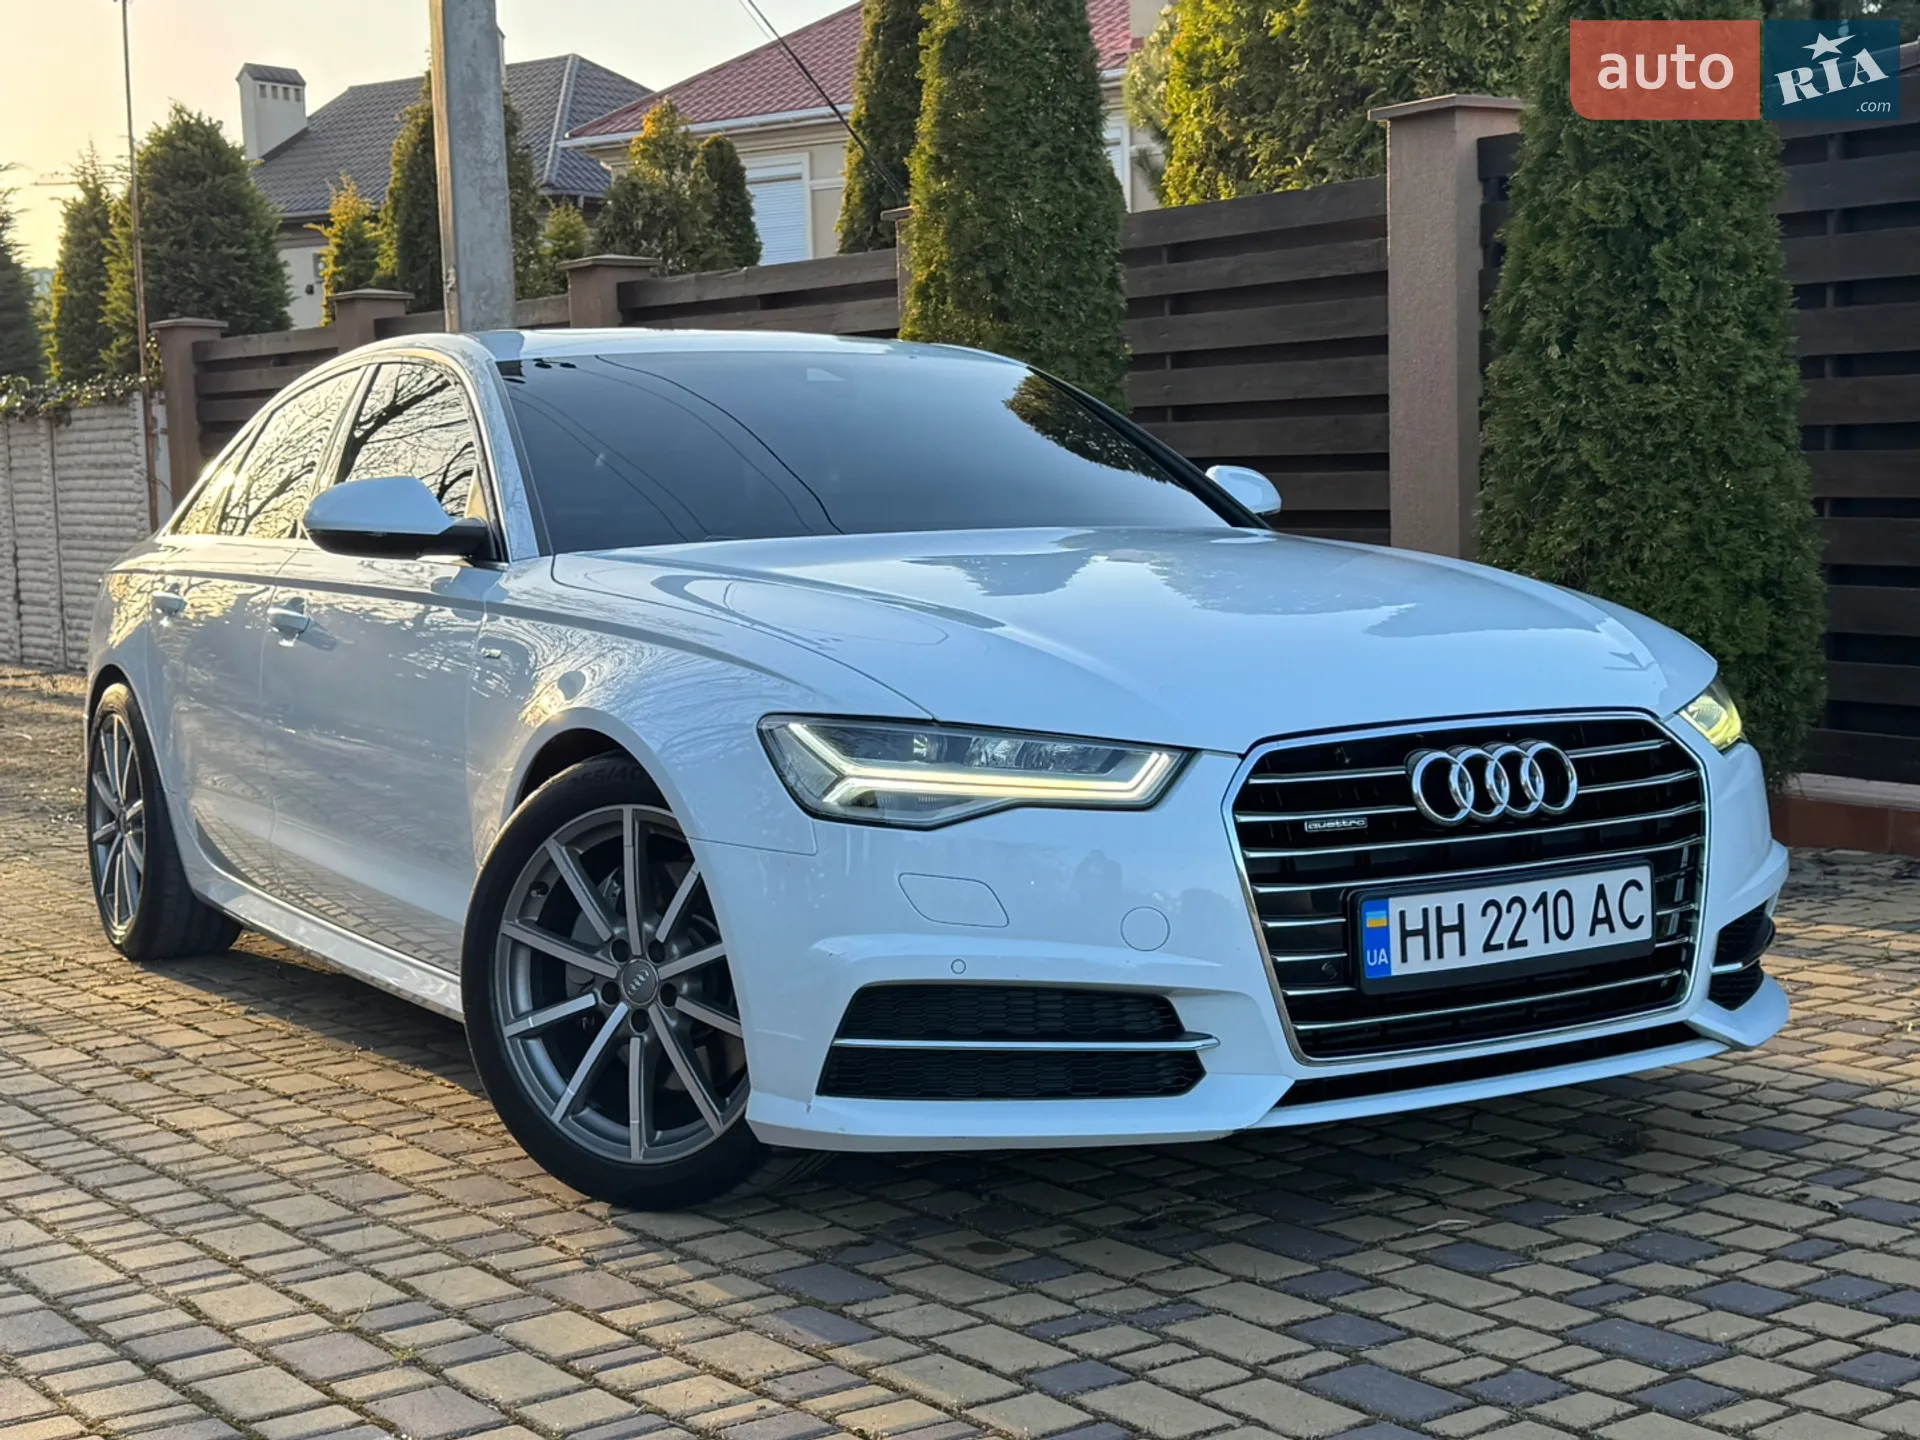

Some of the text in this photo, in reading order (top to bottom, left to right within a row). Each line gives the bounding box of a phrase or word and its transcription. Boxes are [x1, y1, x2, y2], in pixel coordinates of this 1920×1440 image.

[1307, 818, 1366, 830] quattro
[1398, 878, 1645, 964] HH 2210 AC
[1366, 949, 1389, 966] UA
